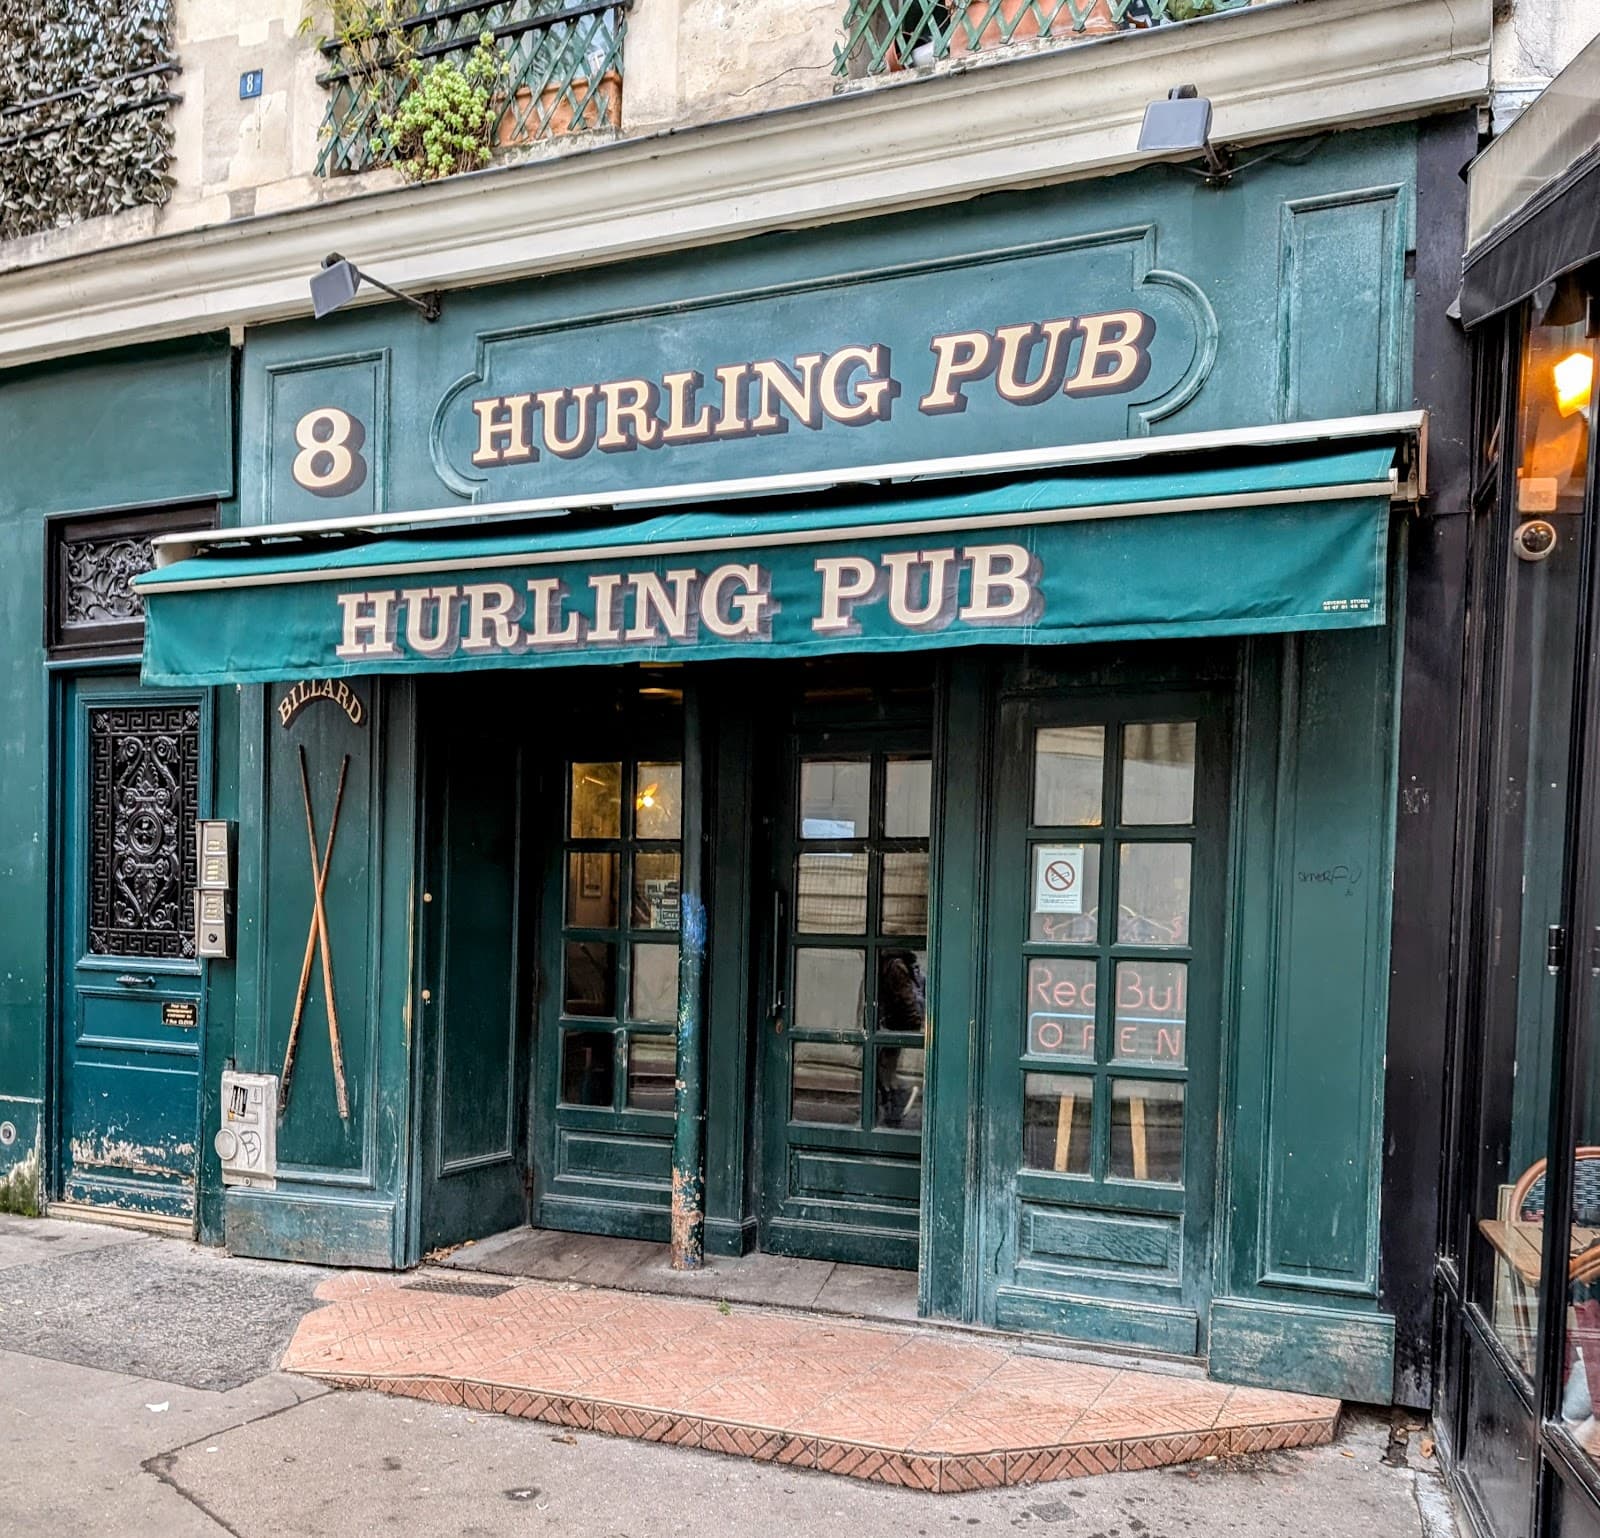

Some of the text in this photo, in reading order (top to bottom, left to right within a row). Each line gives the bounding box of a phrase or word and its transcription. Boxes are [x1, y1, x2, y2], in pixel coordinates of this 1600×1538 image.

[246, 73, 254, 93] 8
[472, 309, 1156, 467] HURLING PUB
[292, 407, 367, 497] 8
[336, 544, 1042, 660] HURLING PUB
[278, 679, 366, 727] BILLARD
